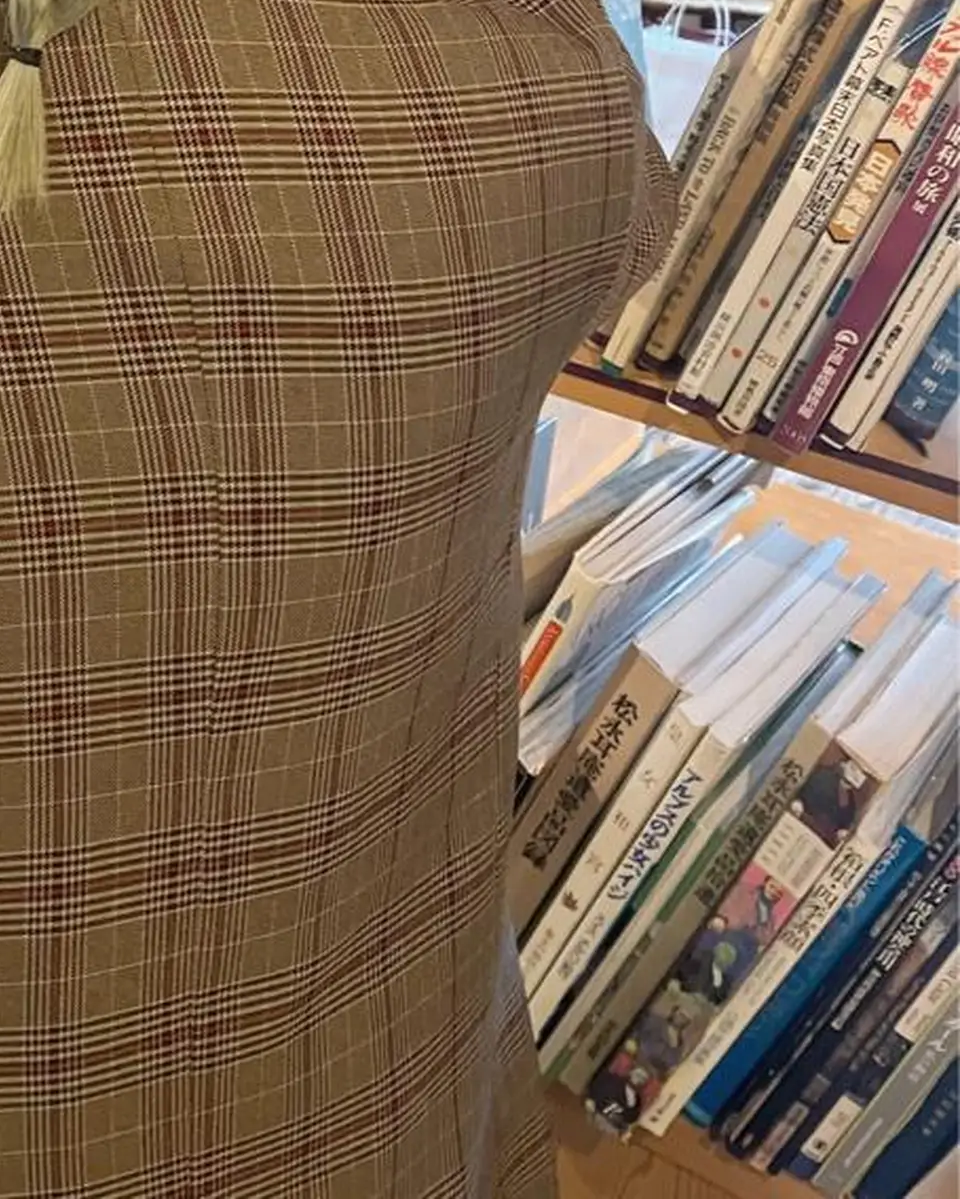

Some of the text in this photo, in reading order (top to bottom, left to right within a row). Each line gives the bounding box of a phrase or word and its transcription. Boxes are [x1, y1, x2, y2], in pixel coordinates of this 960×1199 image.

[798, 136, 860, 237] 日本国憲法
[607, 768, 704, 900] アルプスの少女ハイジ
